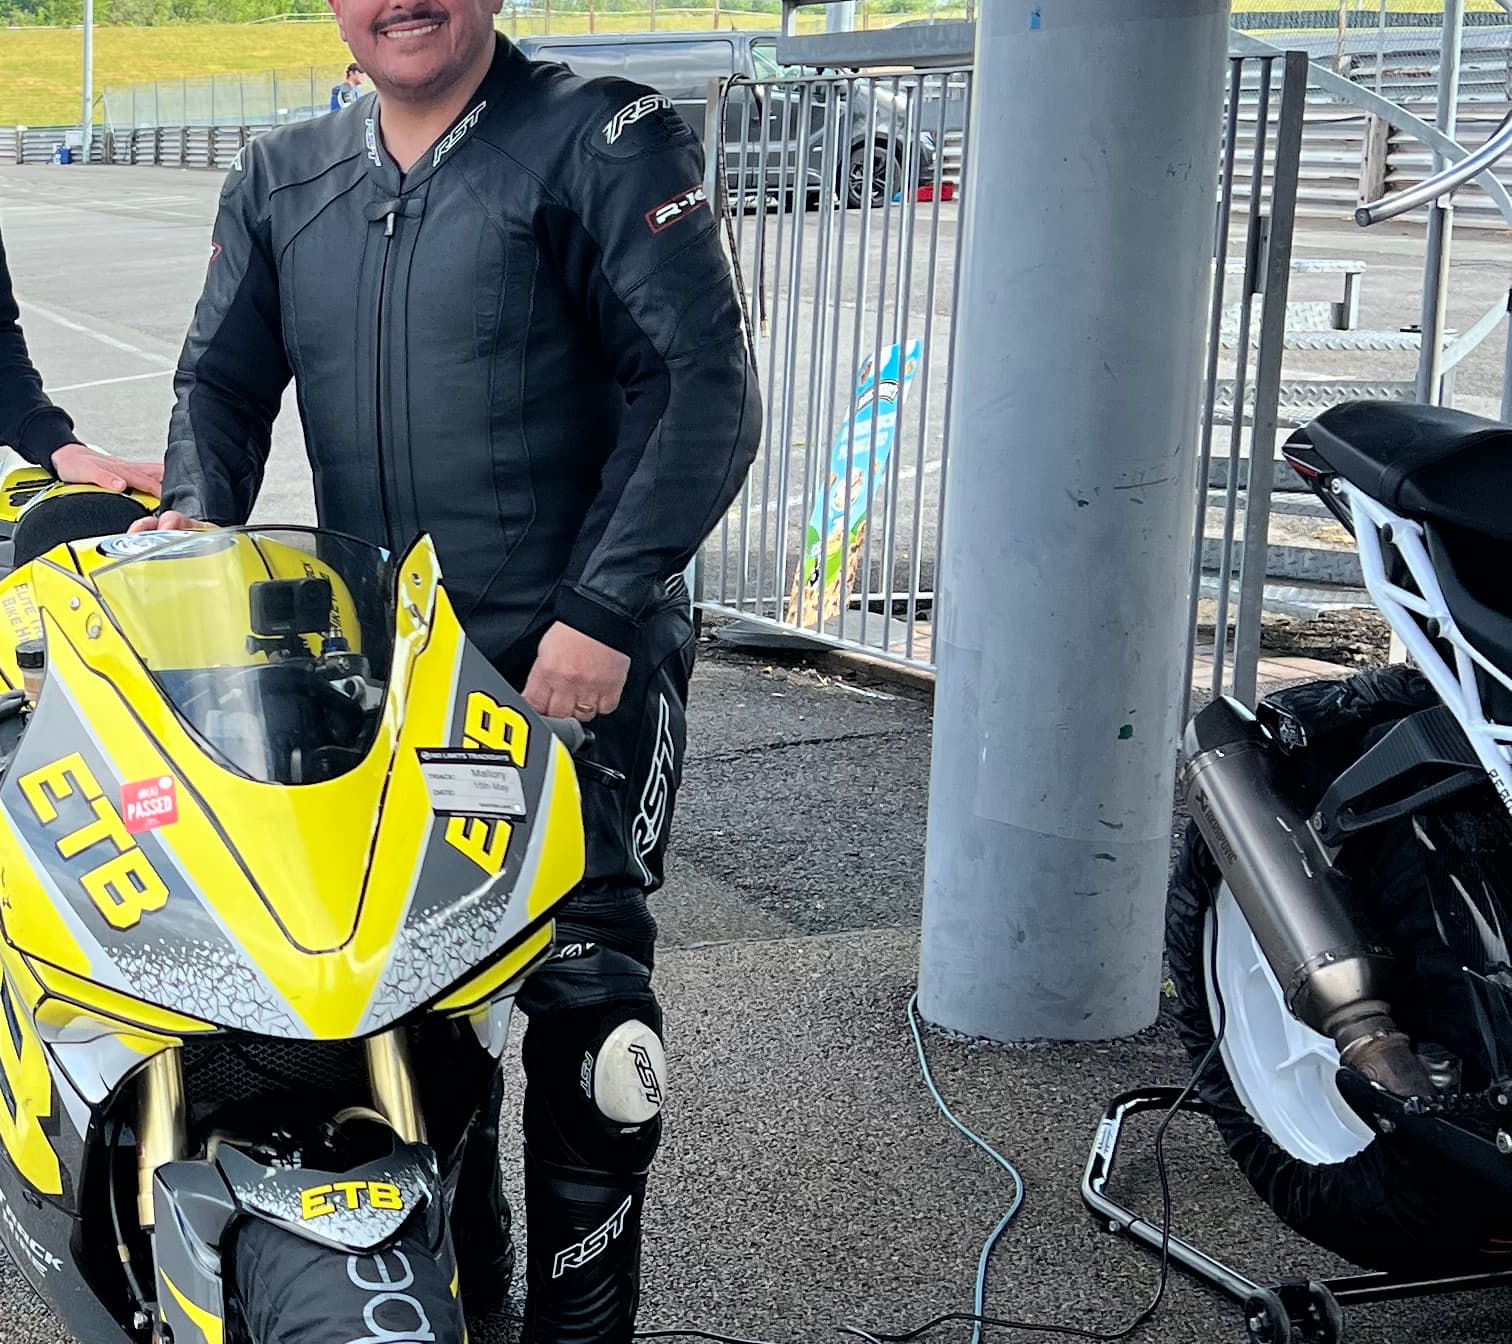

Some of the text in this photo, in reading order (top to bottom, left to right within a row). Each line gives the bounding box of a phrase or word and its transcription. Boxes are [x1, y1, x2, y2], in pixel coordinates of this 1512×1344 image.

[432, 100, 486, 167] RST
[127, 795, 173, 822] PASSED
[445, 690, 531, 878] EB
[632, 692, 675, 886] RST
[17, 751, 171, 933] ETB
[628, 1043, 663, 1108] RST
[301, 1181, 403, 1221] ETB
[552, 1194, 632, 1278] RST
